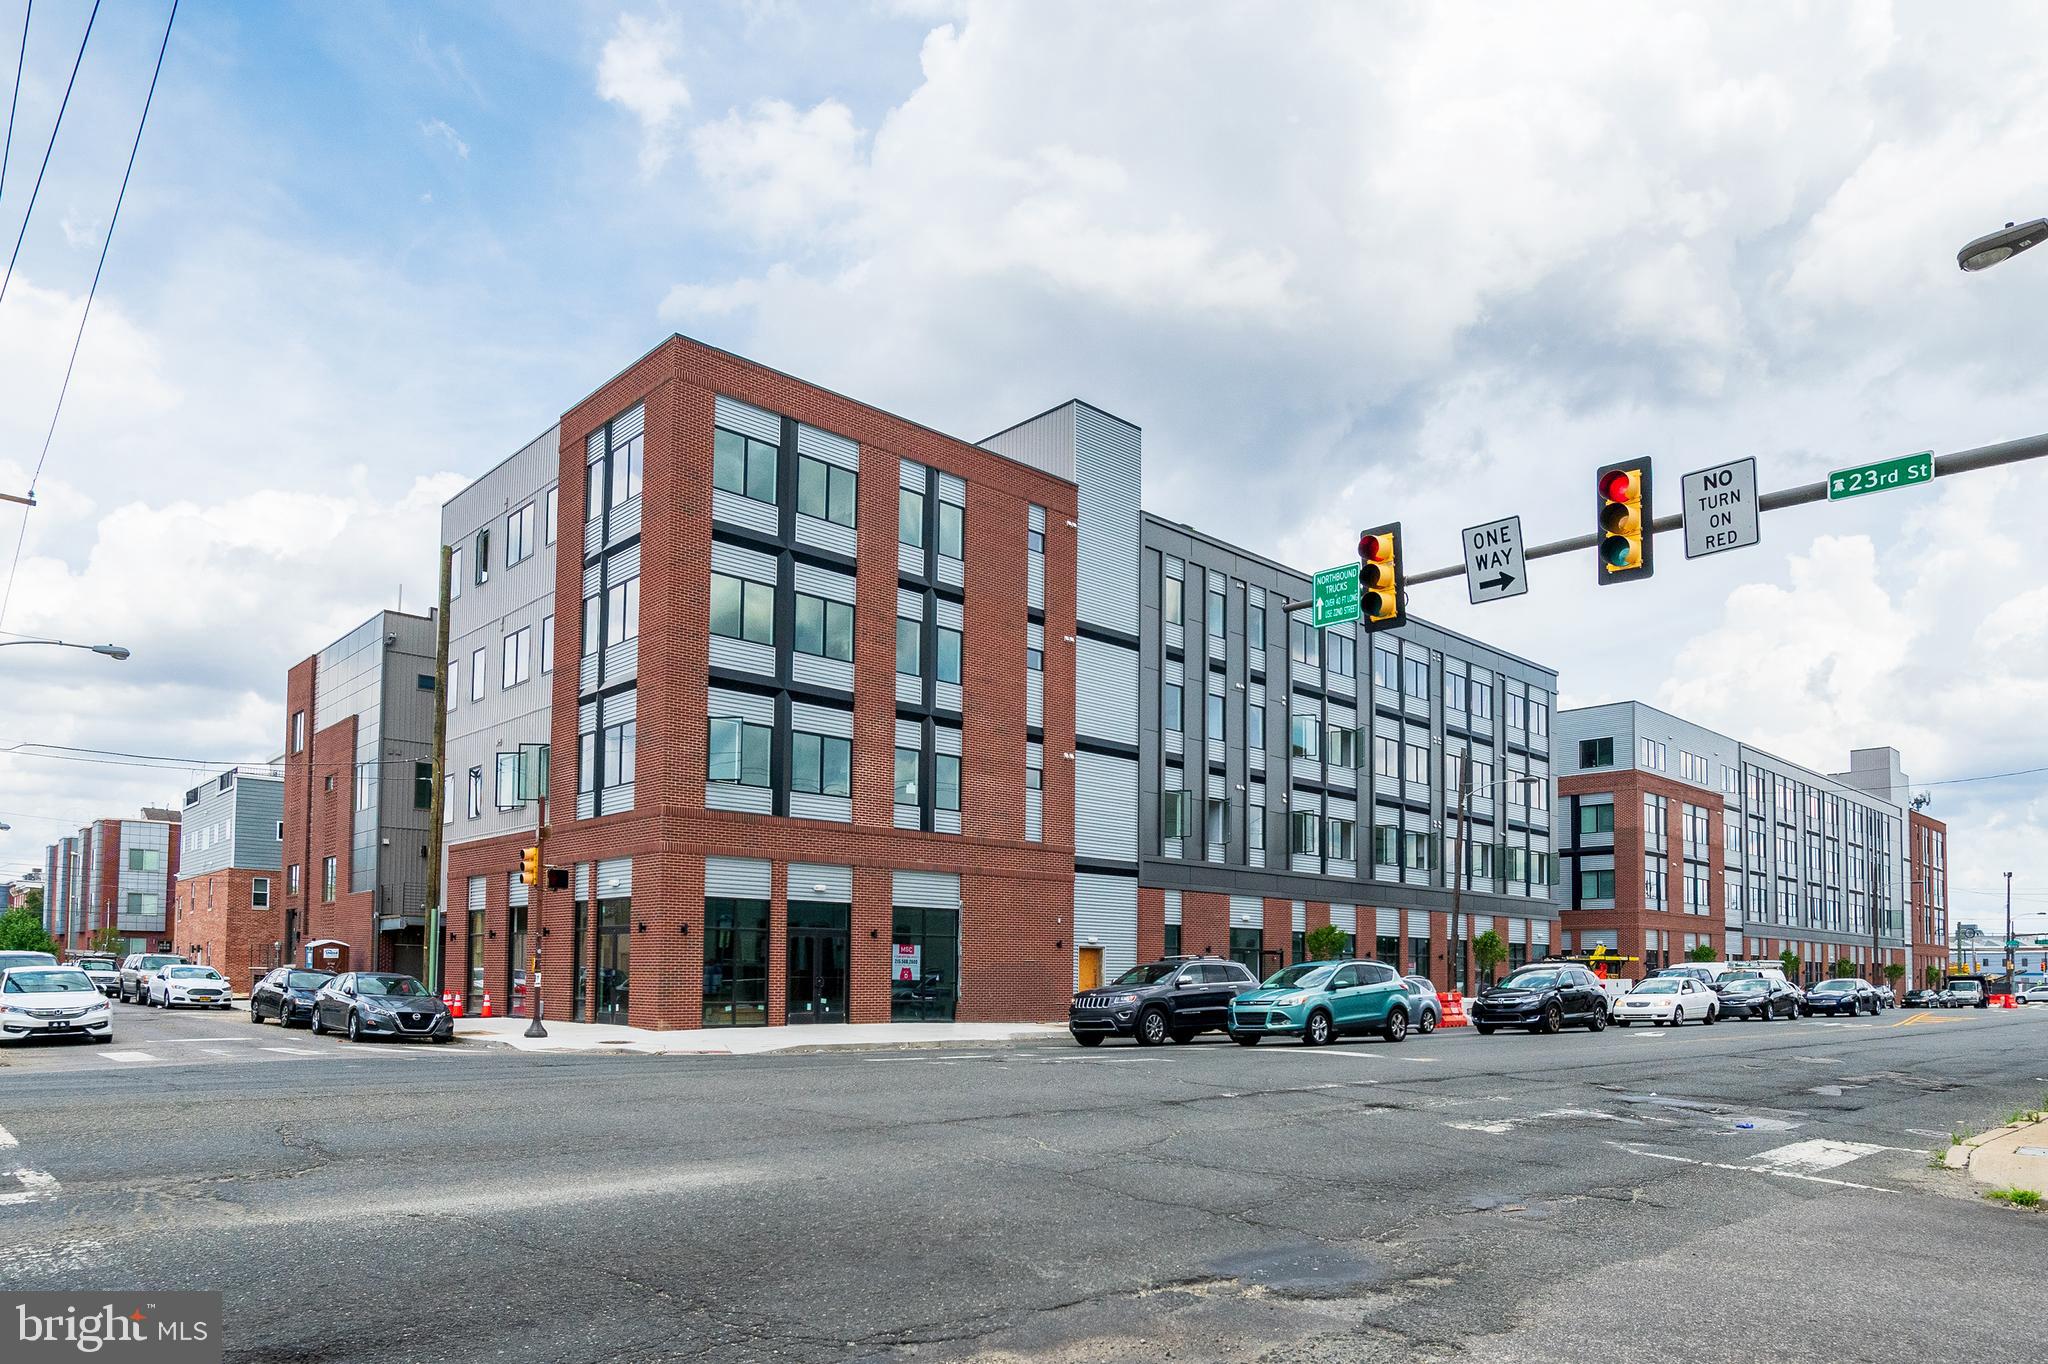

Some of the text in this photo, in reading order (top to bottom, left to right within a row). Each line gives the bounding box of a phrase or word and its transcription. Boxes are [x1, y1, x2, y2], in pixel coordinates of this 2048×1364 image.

[1703, 469, 1733, 491] NO
[1848, 463, 1928, 492] 23rd St
[1698, 489, 1741, 512] TURN
[1709, 511, 1732, 529] ON
[1473, 525, 1511, 550] ONE
[1705, 530, 1738, 549] RED
[1475, 547, 1513, 572] WAY
[1317, 568, 1357, 585] NORTHBOUND
[1325, 581, 1348, 595] TRUCKS
